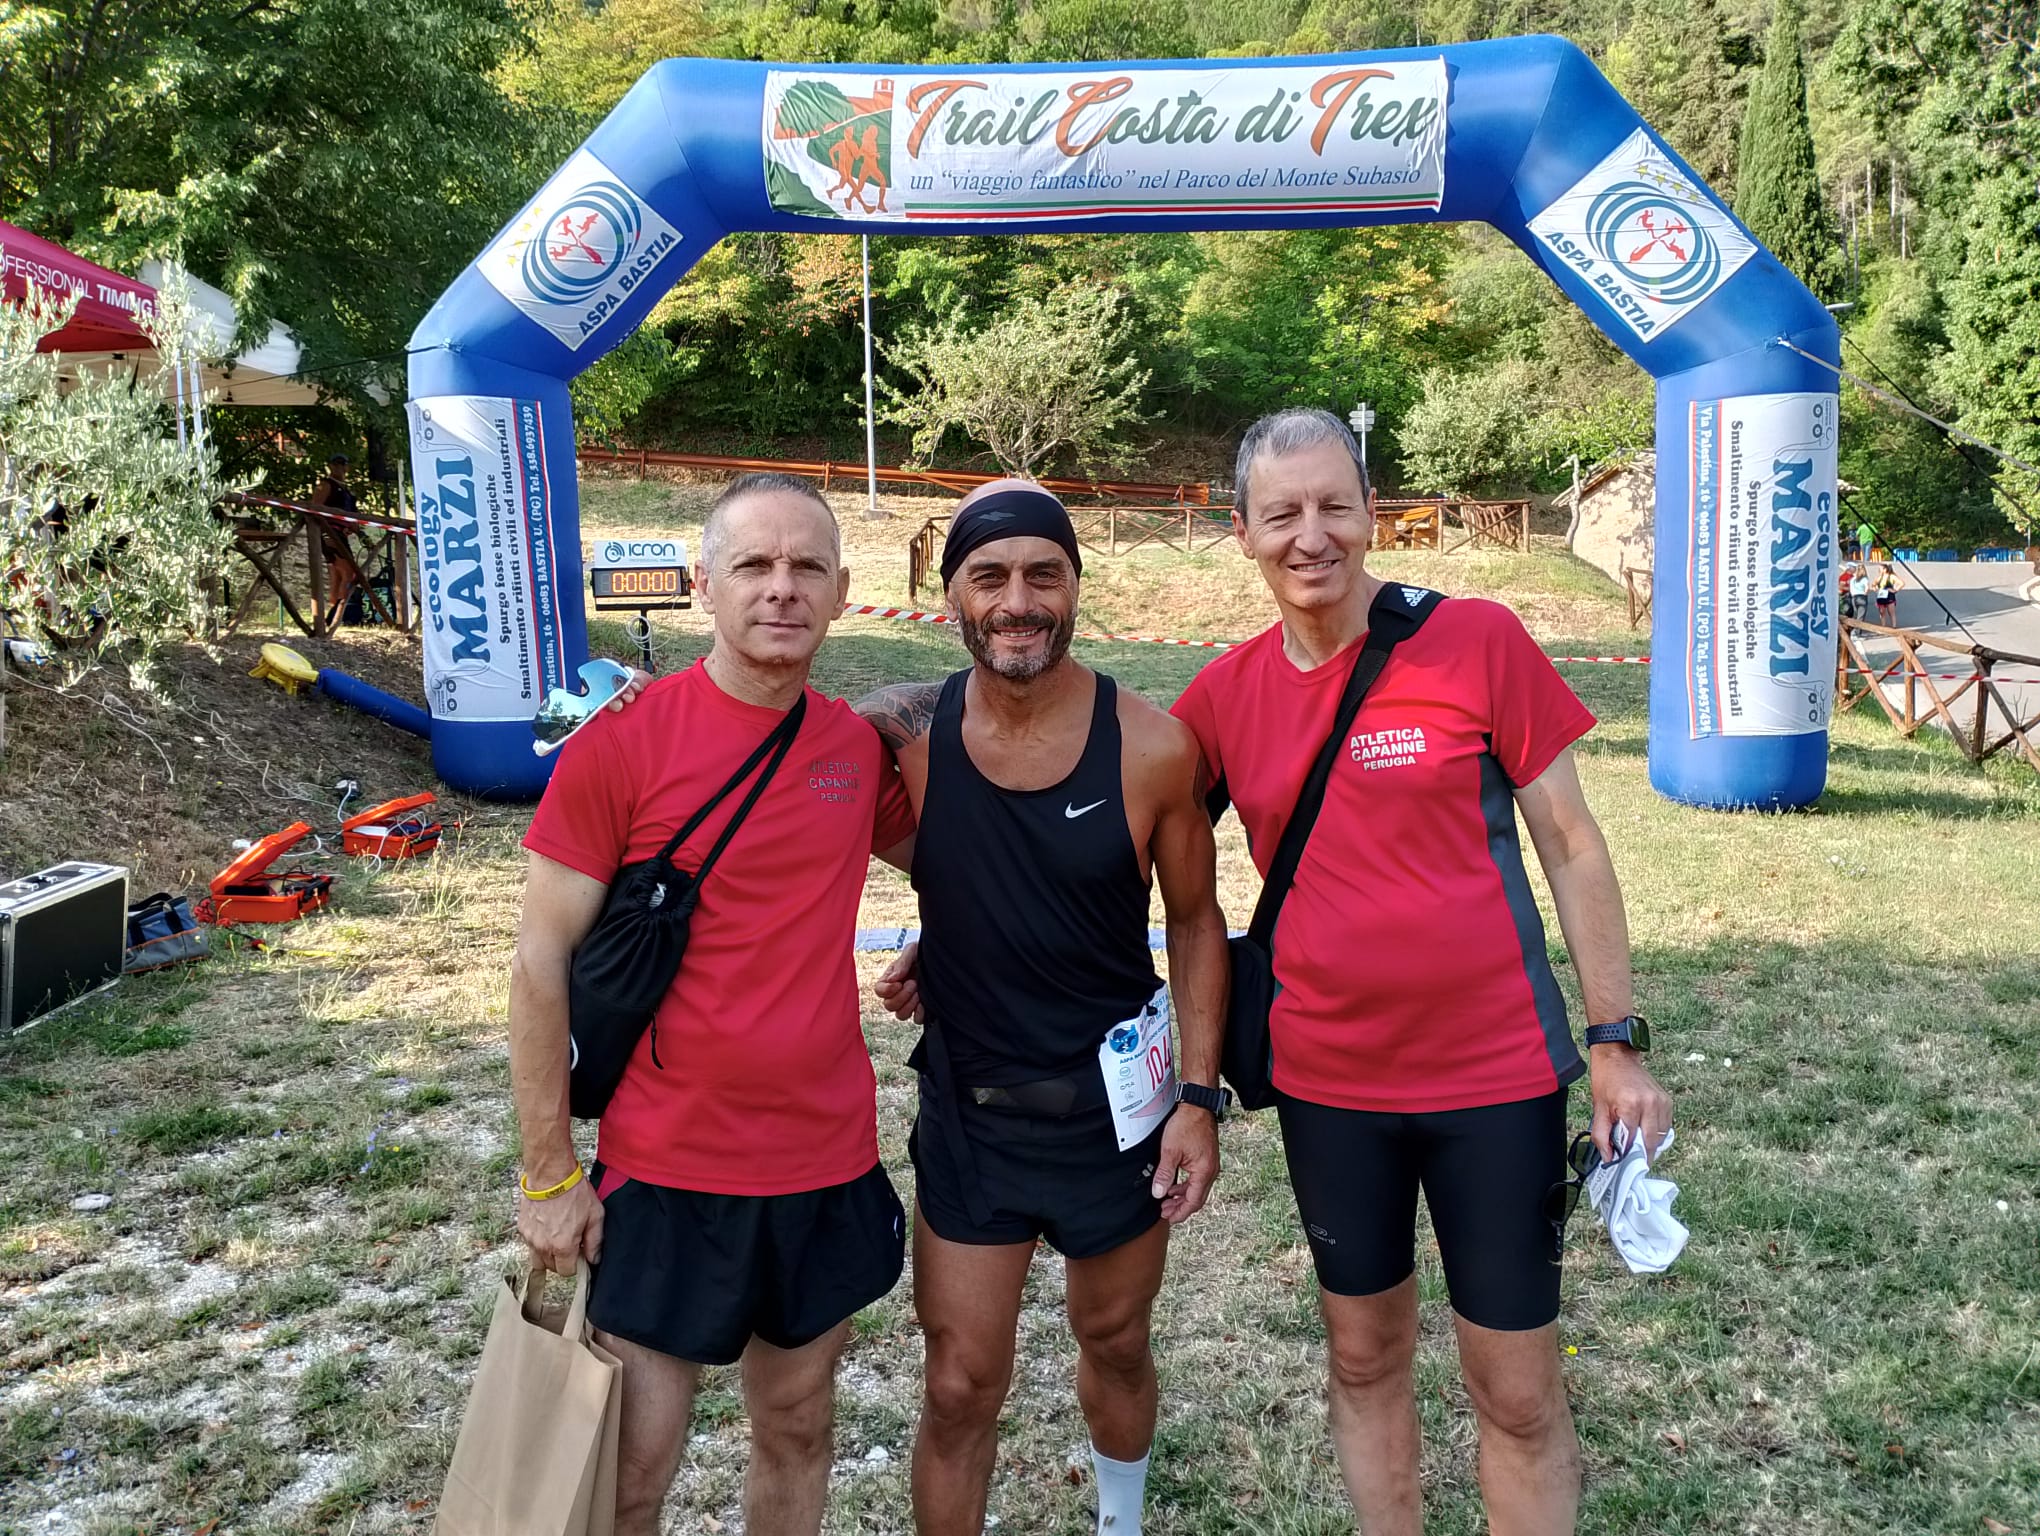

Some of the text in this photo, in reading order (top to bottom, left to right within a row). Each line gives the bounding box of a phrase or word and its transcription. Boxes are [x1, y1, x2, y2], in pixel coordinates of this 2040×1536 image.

[906, 69, 1438, 159] Trail Costa di Trex
[910, 174, 934, 190] un
[1138, 167, 1169, 188] nel
[1174, 169, 1230, 188] Parco
[1236, 167, 1268, 188] del
[1272, 167, 1338, 188] Monte
[1343, 164, 1421, 185] Subasio
[579, 231, 676, 336] ASPA BASTIA
[1545, 232, 1656, 334] ASPA BASTIA
[1701, 407, 1713, 426] Via
[1699, 429, 1712, 486] Palestina,
[530, 474, 540, 493] Tel.
[530, 496, 543, 521] (PG)
[534, 524, 543, 535] U.
[1698, 511, 1709, 545] 06083
[436, 456, 490, 663] MARZI
[486, 474, 512, 644] Spurgo fosse biologiche
[495, 419, 531, 699] Smaltimento rifiuti civili ed industriali
[535, 539, 547, 581] BASTIA
[1698, 548, 1709, 594] BASTIA
[1728, 421, 1743, 716] Smaltimento rifiuti civili ed industriali
[1743, 481, 1761, 659] Spurgo fosse biologiche
[1770, 458, 1812, 677] MARZI
[1811, 492, 1831, 641] ecology
[539, 584, 550, 615] 06083
[1698, 596, 1709, 609] U.
[545, 624, 553, 636] 16
[1696, 612, 1710, 639] (PG)
[1697, 642, 1708, 662] Tel.
[1350, 727, 1425, 749] ATLETICA
[1351, 740, 1427, 762] CAPANNE
[810, 762, 860, 774] ATLETICA
[1363, 755, 1417, 771] PERUGIA
[809, 777, 861, 791] CAPANNE
[820, 792, 857, 803] PERUGIA
[1146, 1028, 1172, 1092] 104
